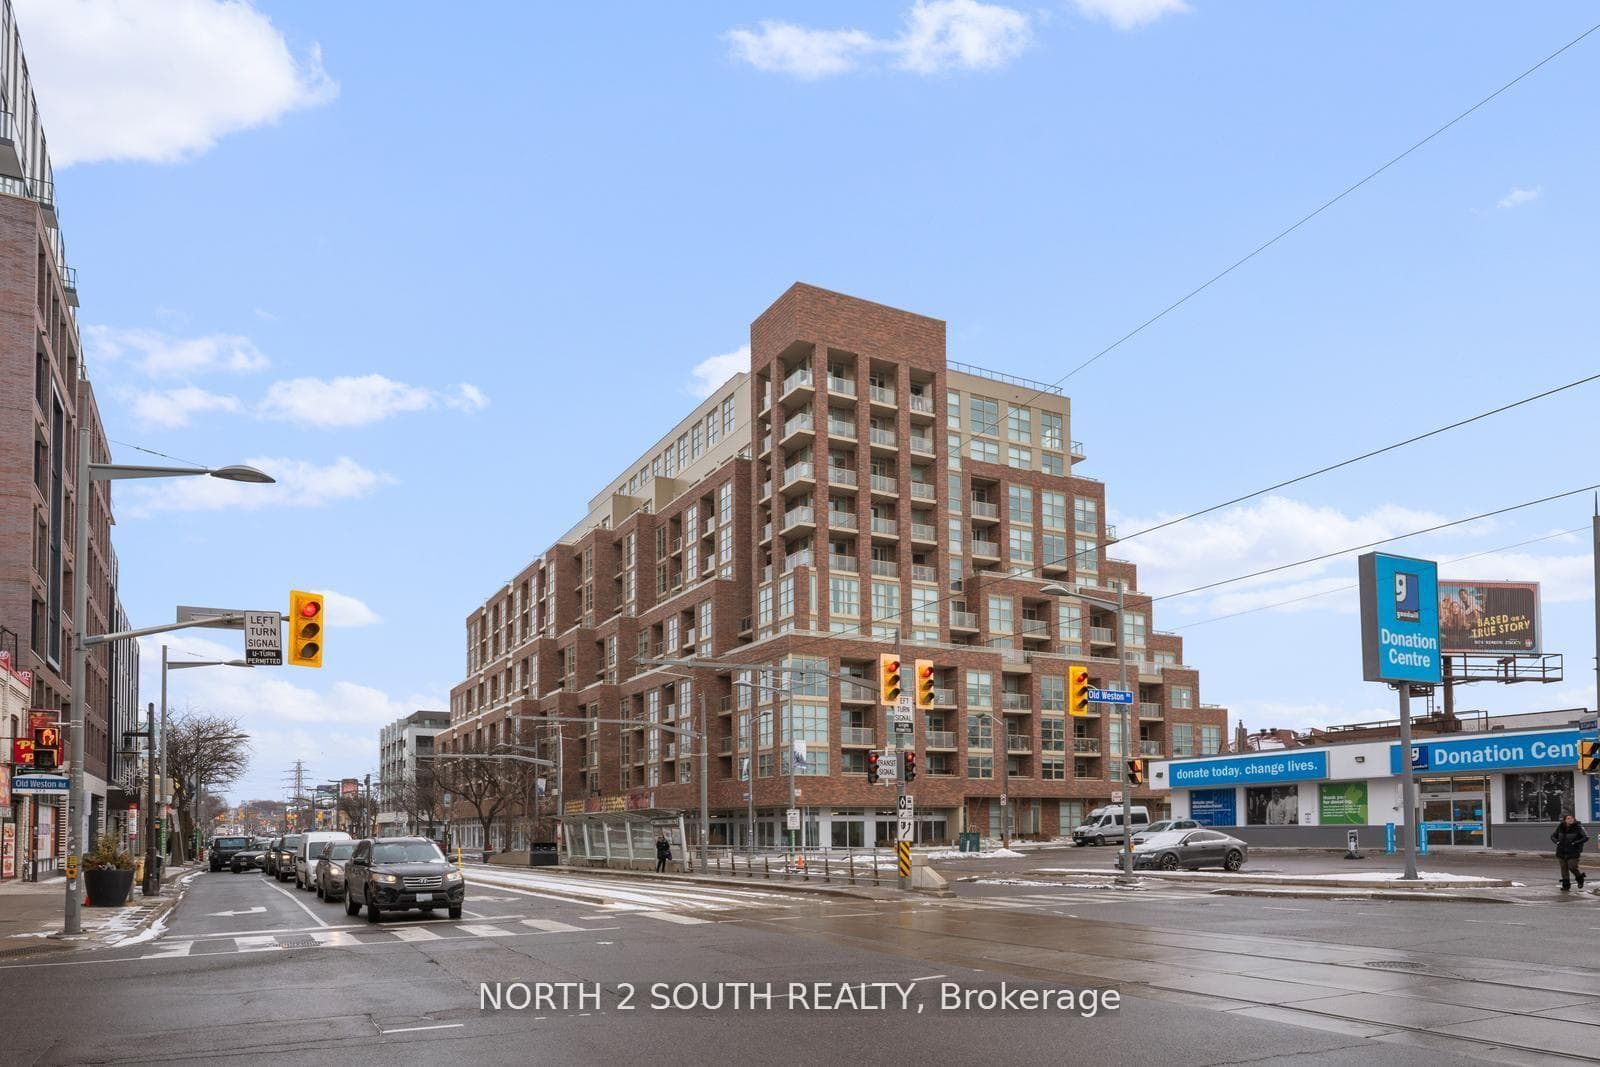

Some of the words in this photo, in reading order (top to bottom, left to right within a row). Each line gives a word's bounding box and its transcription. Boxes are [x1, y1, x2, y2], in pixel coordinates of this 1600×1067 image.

[250, 615, 274, 625] LEFT
[1477, 614, 1509, 628] BASED
[250, 627, 276, 636] TURN
[1471, 625, 1497, 638] TRUE
[1499, 620, 1531, 634] STORY
[248, 639, 279, 648] SIGNAL
[1381, 628, 1437, 650] Donation
[1388, 648, 1431, 668] Centre
[1088, 690, 1100, 699] Old
[1101, 691, 1125, 701] Weston
[895, 714, 912, 722] SIGNAL
[1434, 745, 1524, 766] Donation
[878, 759, 897, 767] TRANSIT
[879, 768, 895, 776] SIGNAL
[1176, 768, 1210, 779] donate
[1211, 766, 1242, 778] today.
[1244, 762, 1285, 776] change
[1287, 760, 1318, 772] lives.
[16, 779, 28, 787] Old
[30, 780, 57, 788] Weston
